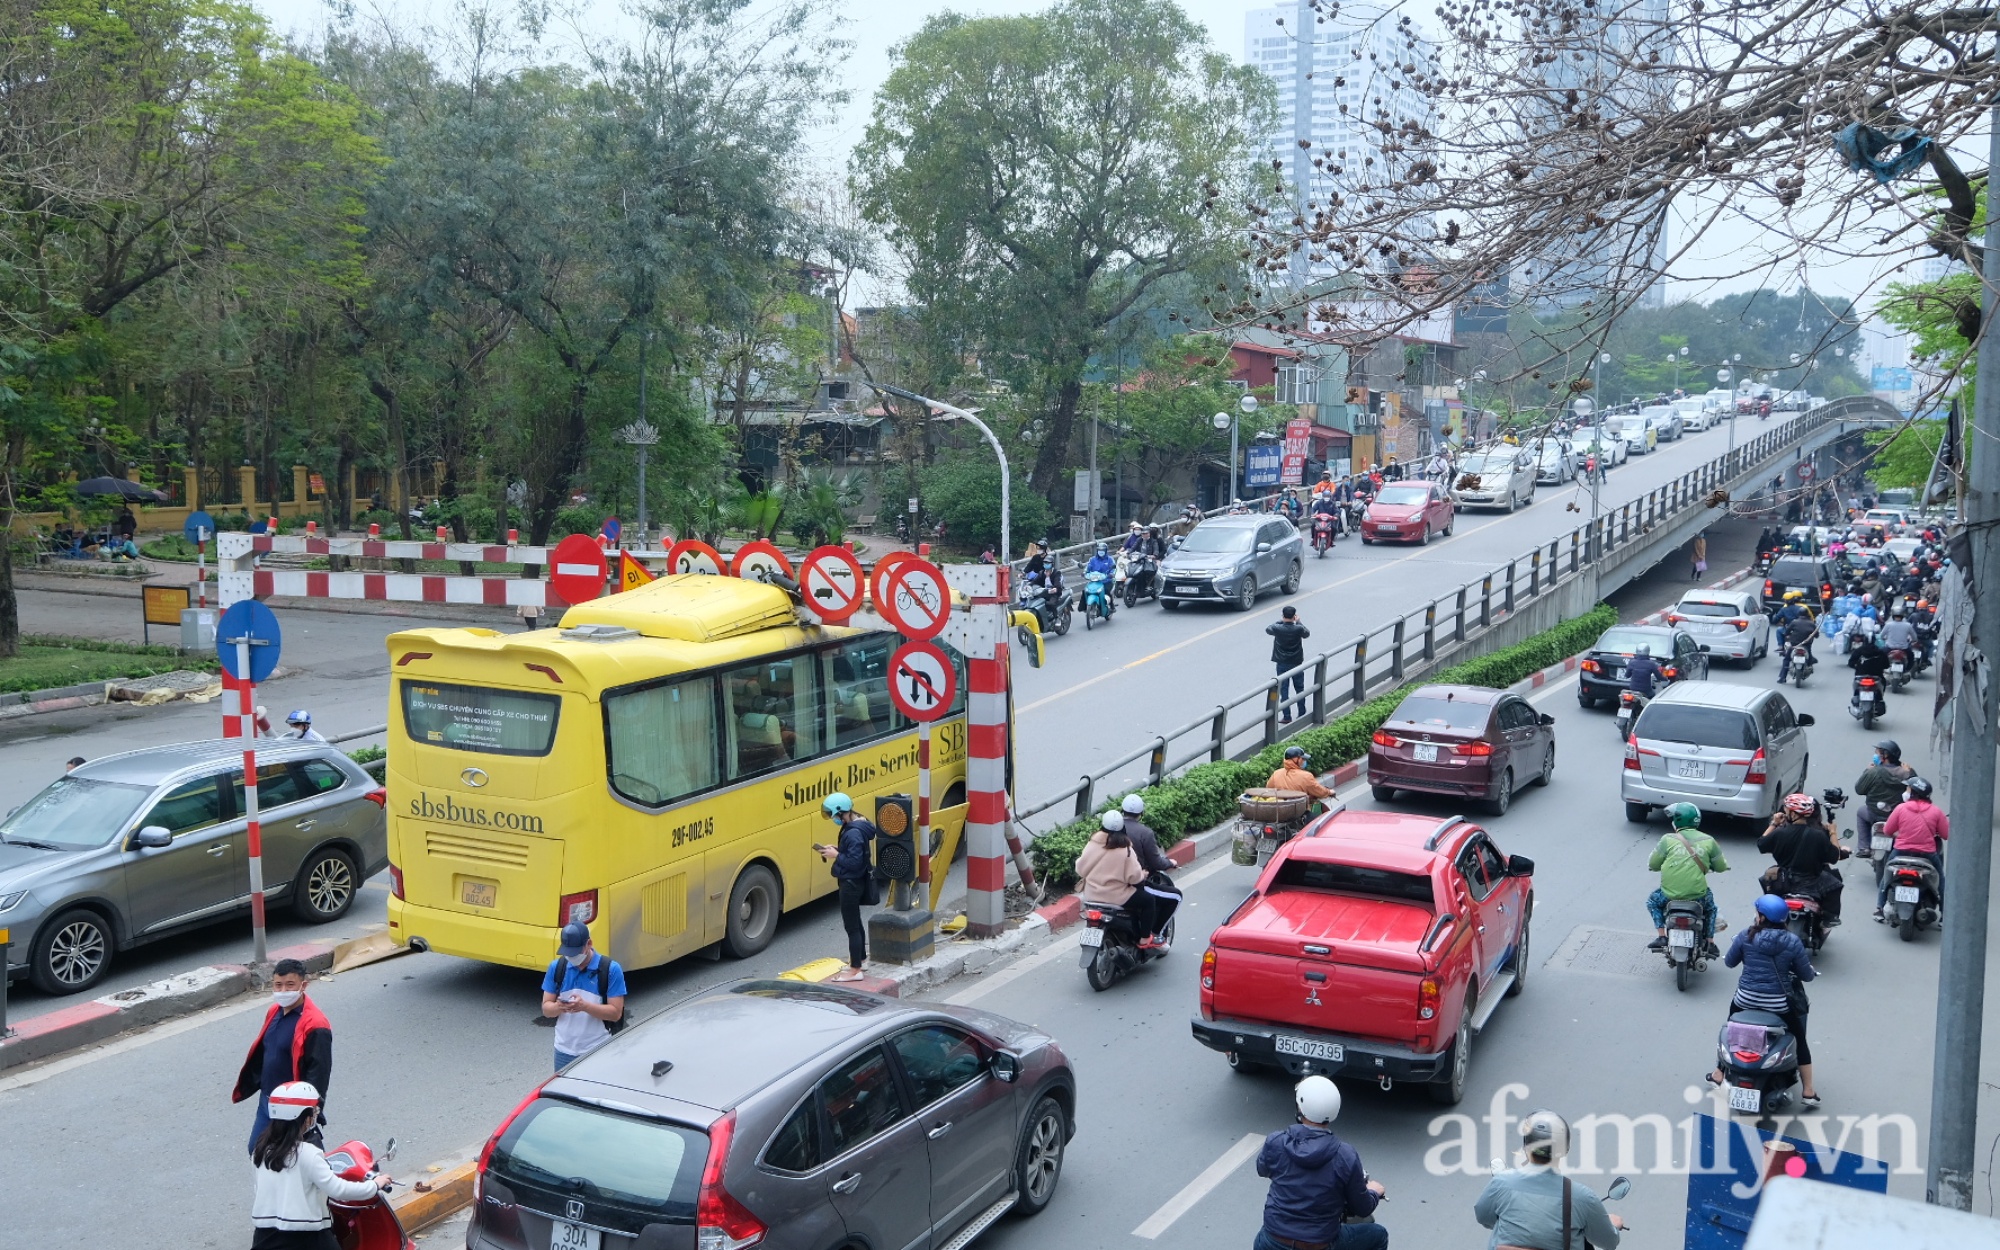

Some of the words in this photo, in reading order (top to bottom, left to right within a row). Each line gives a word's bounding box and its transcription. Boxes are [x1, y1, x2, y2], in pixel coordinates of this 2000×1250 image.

[627, 570, 640, 583] ĐI
[515, 712, 530, 720] CHO
[783, 771, 842, 811] Shuttle
[847, 763, 876, 788] Bus
[410, 791, 545, 834] sbsbus.com
[672, 816, 714, 848] 29F-002.45
[465, 893, 491, 905] 002.45
[1277, 1037, 1341, 1060] 35C-073.95
[1731, 1098, 1758, 1110] 468.83
[563, 1224, 588, 1248] 30A
